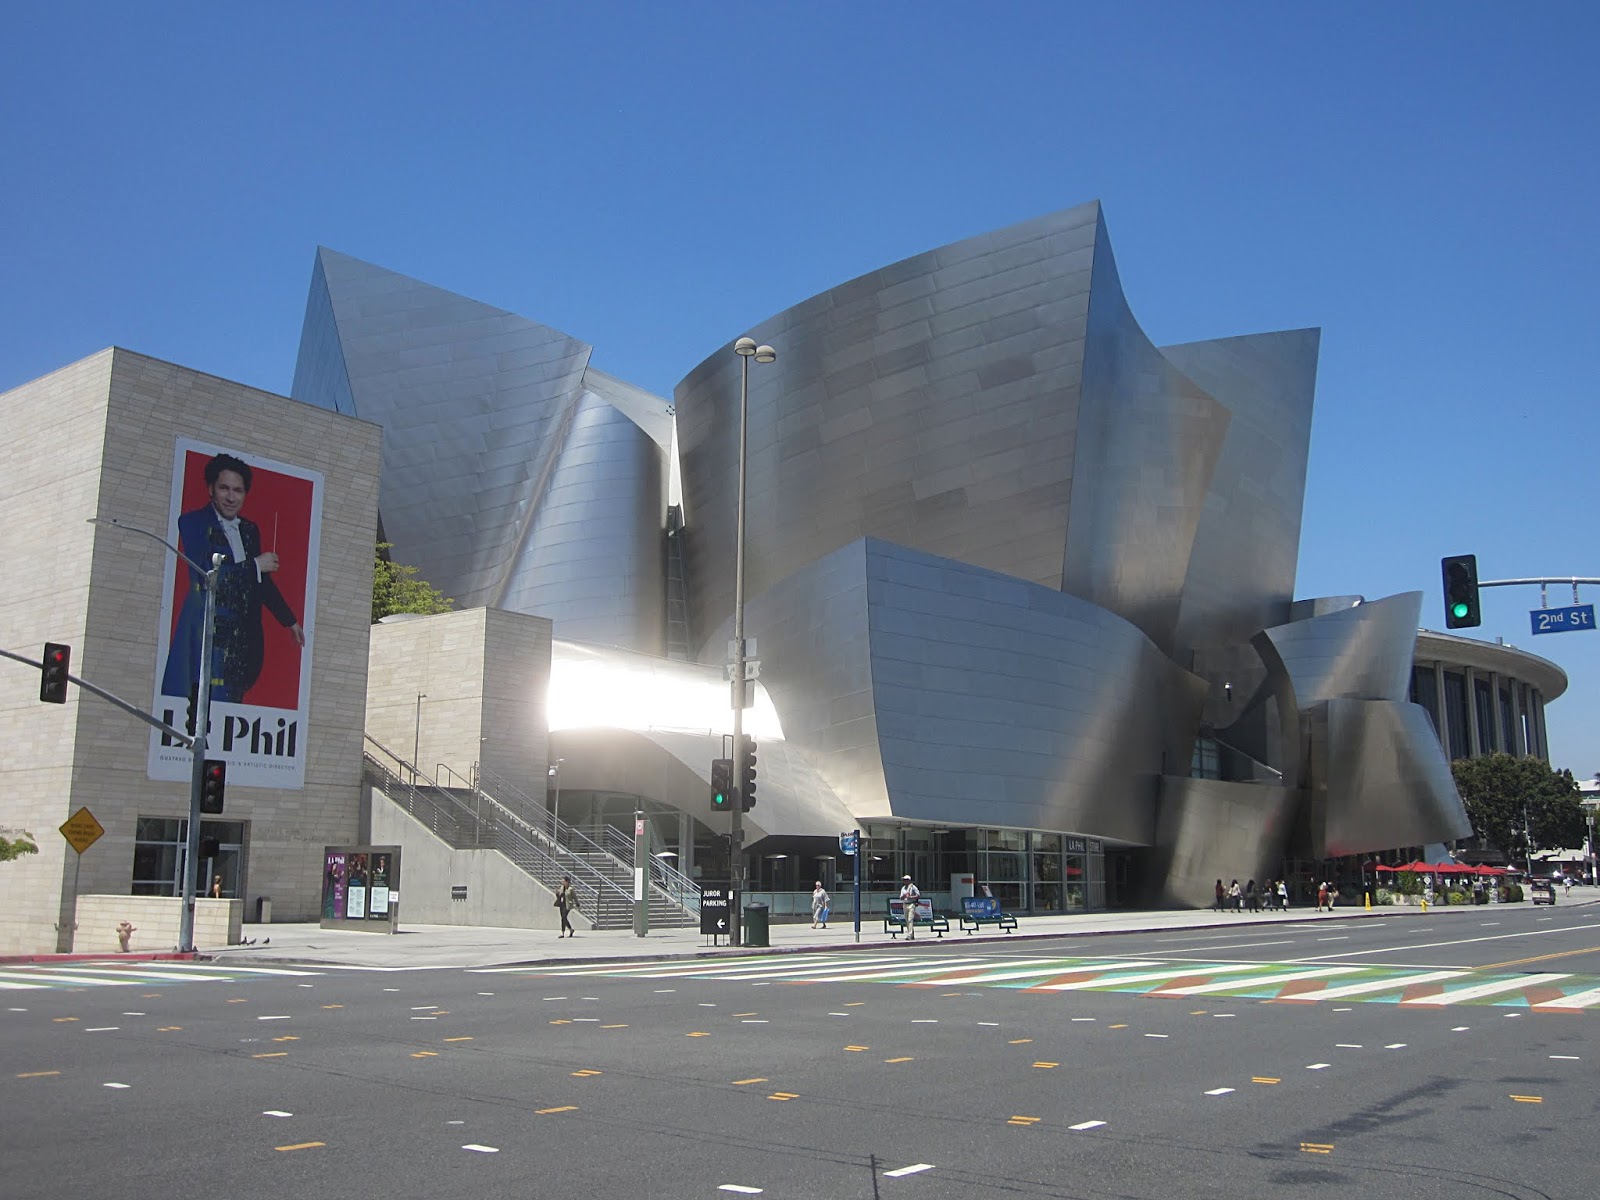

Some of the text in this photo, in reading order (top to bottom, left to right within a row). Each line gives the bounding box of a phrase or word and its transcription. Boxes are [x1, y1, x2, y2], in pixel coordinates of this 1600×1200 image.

[1539, 612, 1588, 630] 2nd St
[223, 716, 297, 757] Phil
